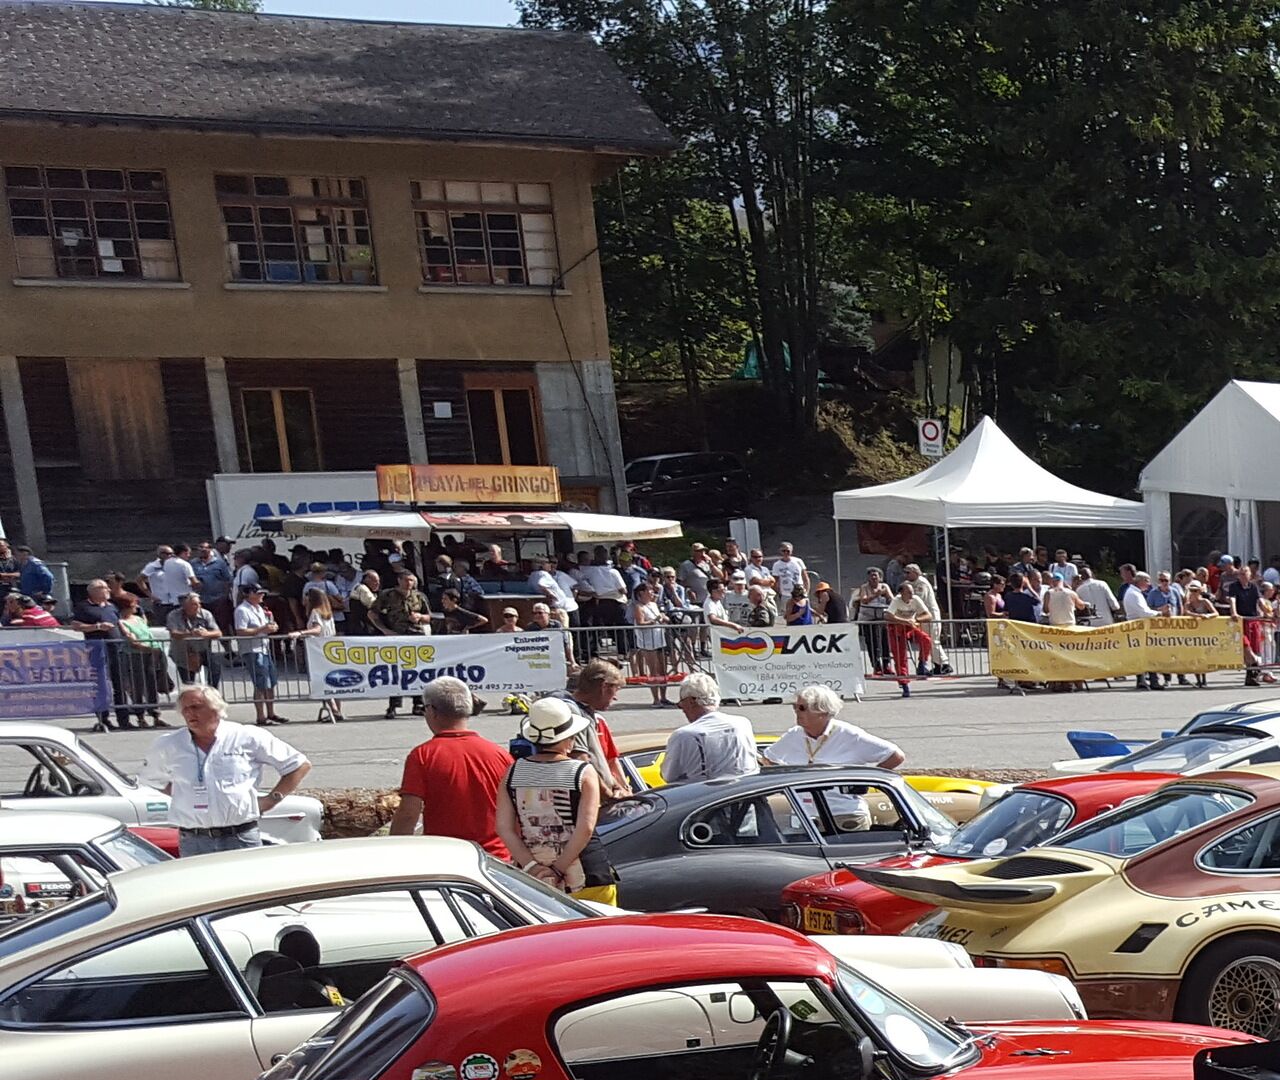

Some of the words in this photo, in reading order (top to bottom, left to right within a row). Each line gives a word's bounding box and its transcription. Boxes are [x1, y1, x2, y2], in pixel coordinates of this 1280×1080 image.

[491, 474, 550, 493] GRINGO
[781, 633, 848, 655] LACK
[1059, 640, 1120, 651] souhaite
[1127, 634, 1141, 648] la
[323, 641, 435, 669] Garage
[29, 667, 98, 683] ESTATE
[739, 682, 764, 695] 024
[770, 681, 797, 694] 495
